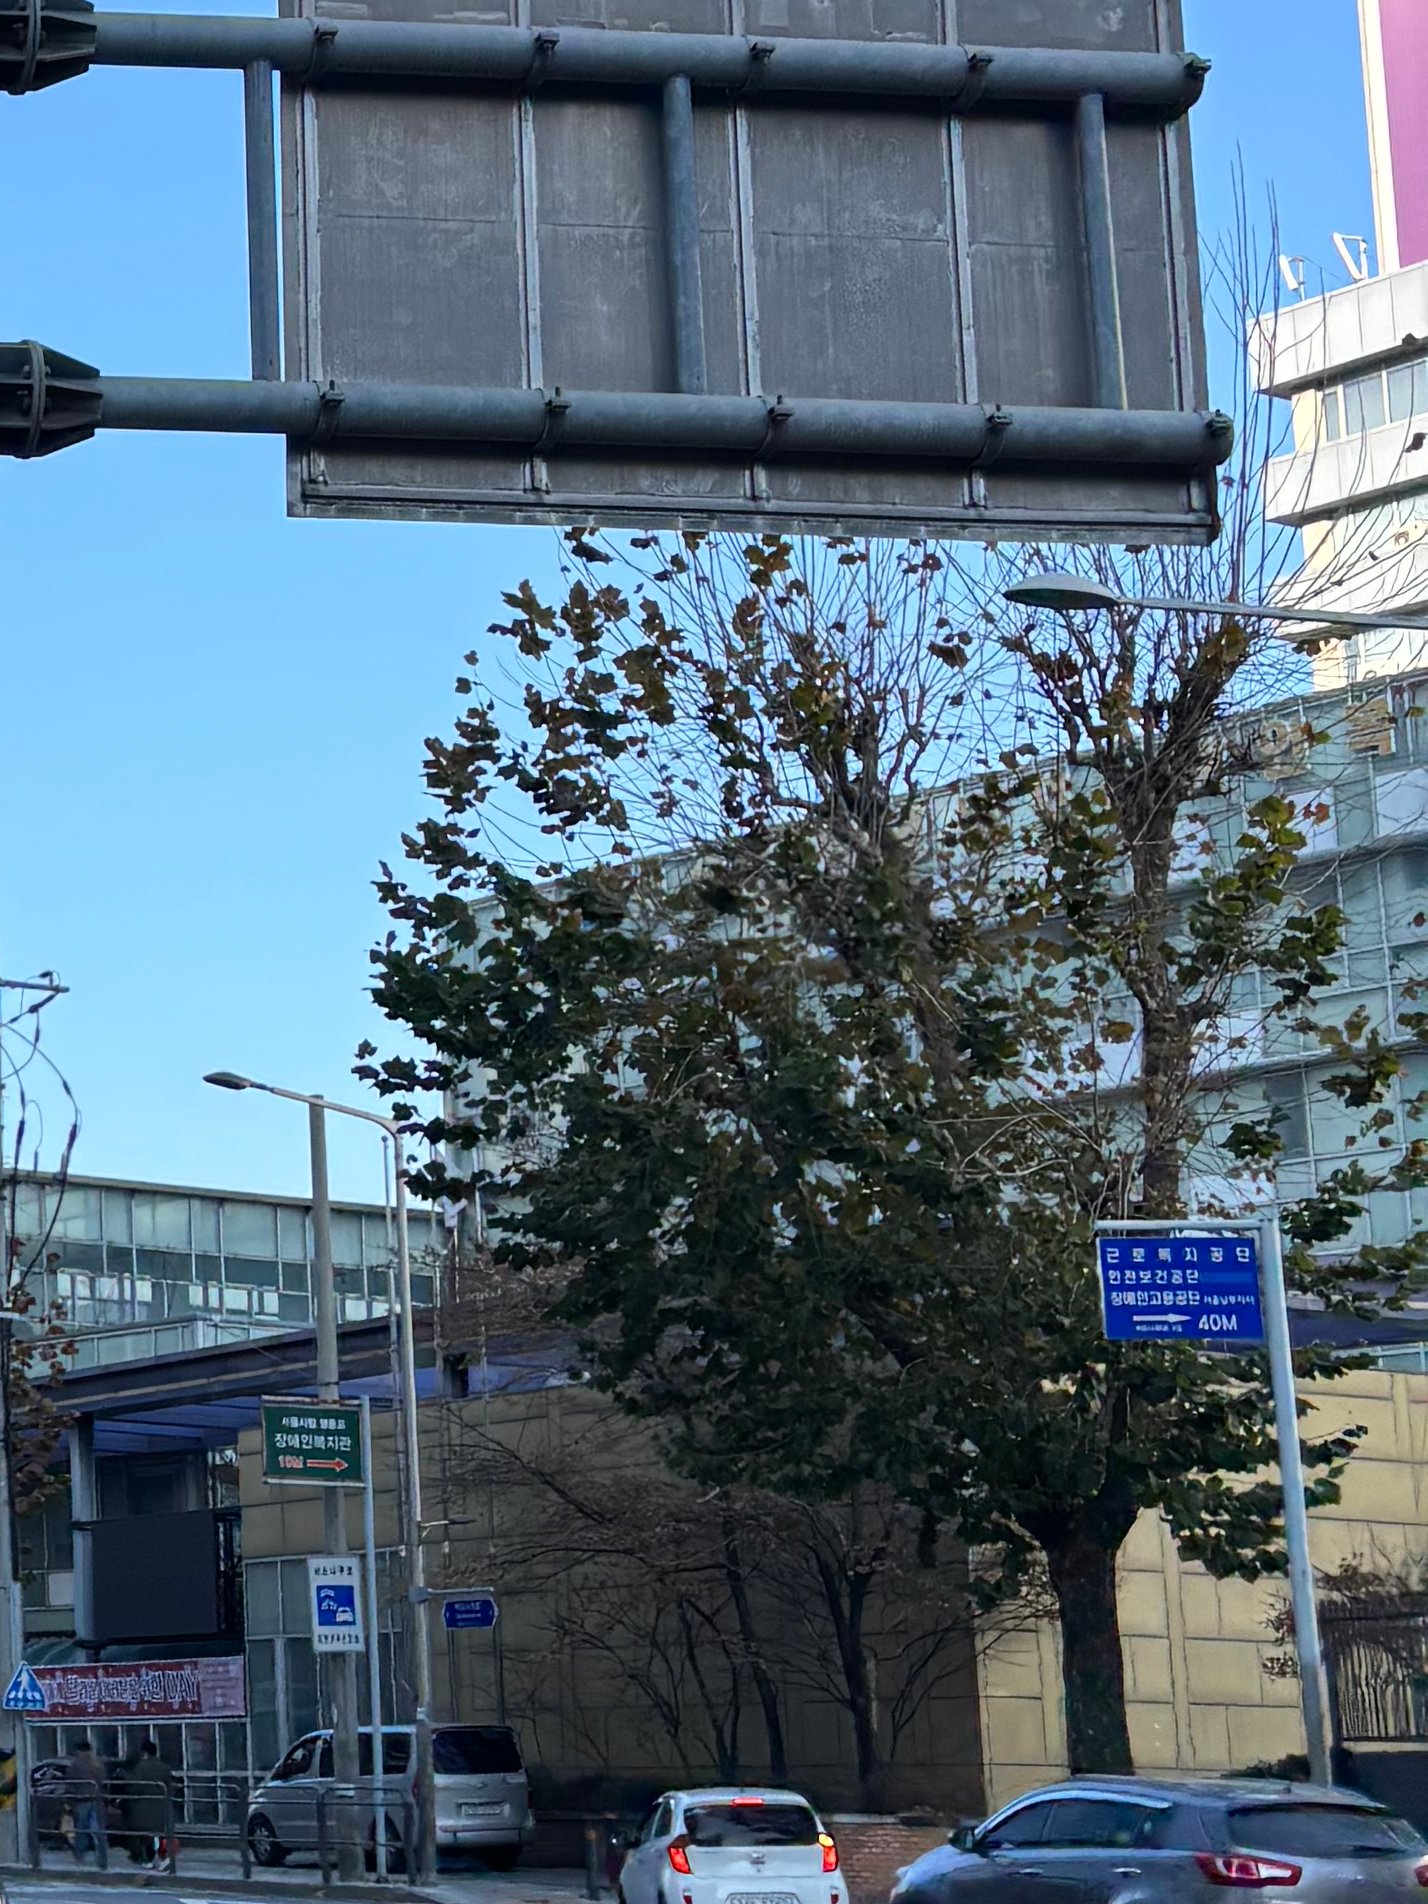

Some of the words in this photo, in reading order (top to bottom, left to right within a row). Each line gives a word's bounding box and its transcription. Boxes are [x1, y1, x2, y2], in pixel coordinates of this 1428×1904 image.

[1108, 1269, 1199, 1285] 안전보건공단
[1198, 1313, 1238, 1332] 40M
[274, 1432, 352, 1451] 장애인복지관
